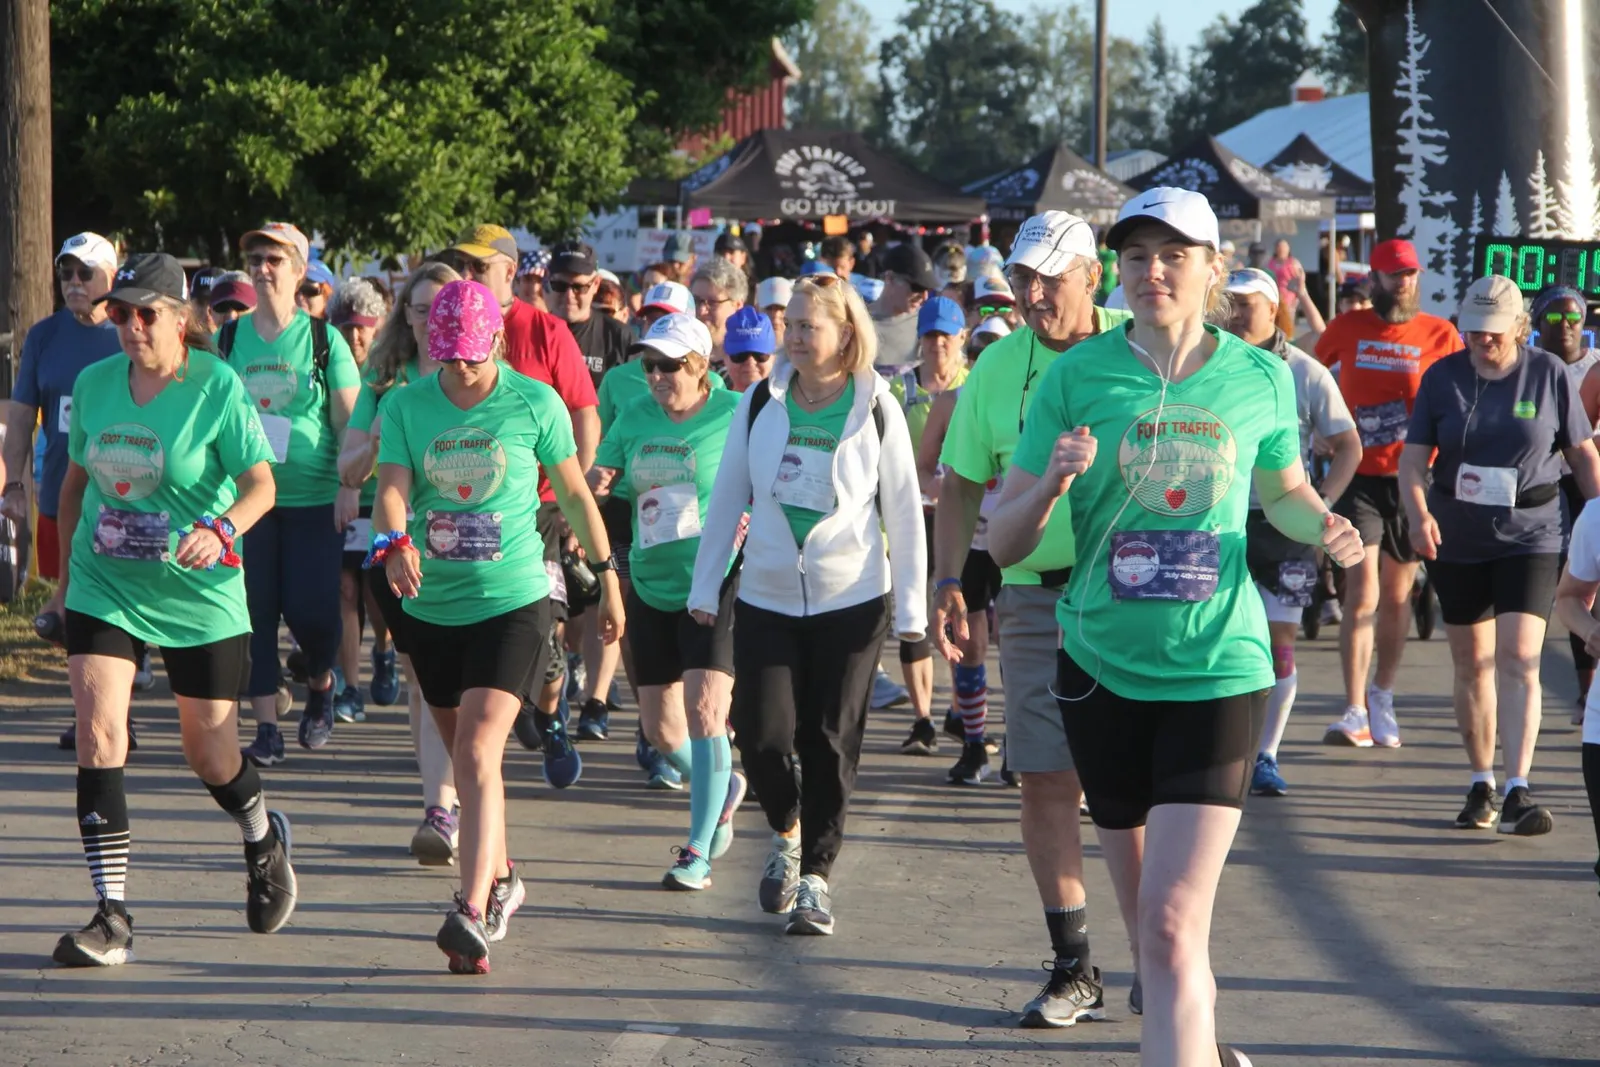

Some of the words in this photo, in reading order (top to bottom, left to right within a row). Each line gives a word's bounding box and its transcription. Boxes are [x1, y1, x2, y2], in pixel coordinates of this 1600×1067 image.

[780, 199, 811, 215] GO
[815, 200, 840, 215] BY
[845, 200, 897, 216] FOOT
[1485, 244, 1600, 294] 00:1
[1137, 422, 1168, 441] FOOT
[1172, 422, 1221, 440] TRAFFIC
[100, 433, 121, 445] FOOT
[124, 435, 156, 451] TRAFFIC
[435, 439, 457, 454] FOOT
[459, 438, 493, 450] TRAFFIC
[804, 437, 835, 450] TRAFFIC
[641, 445, 658, 455] FOOT
[660, 445, 689, 457] TRAFFIC
